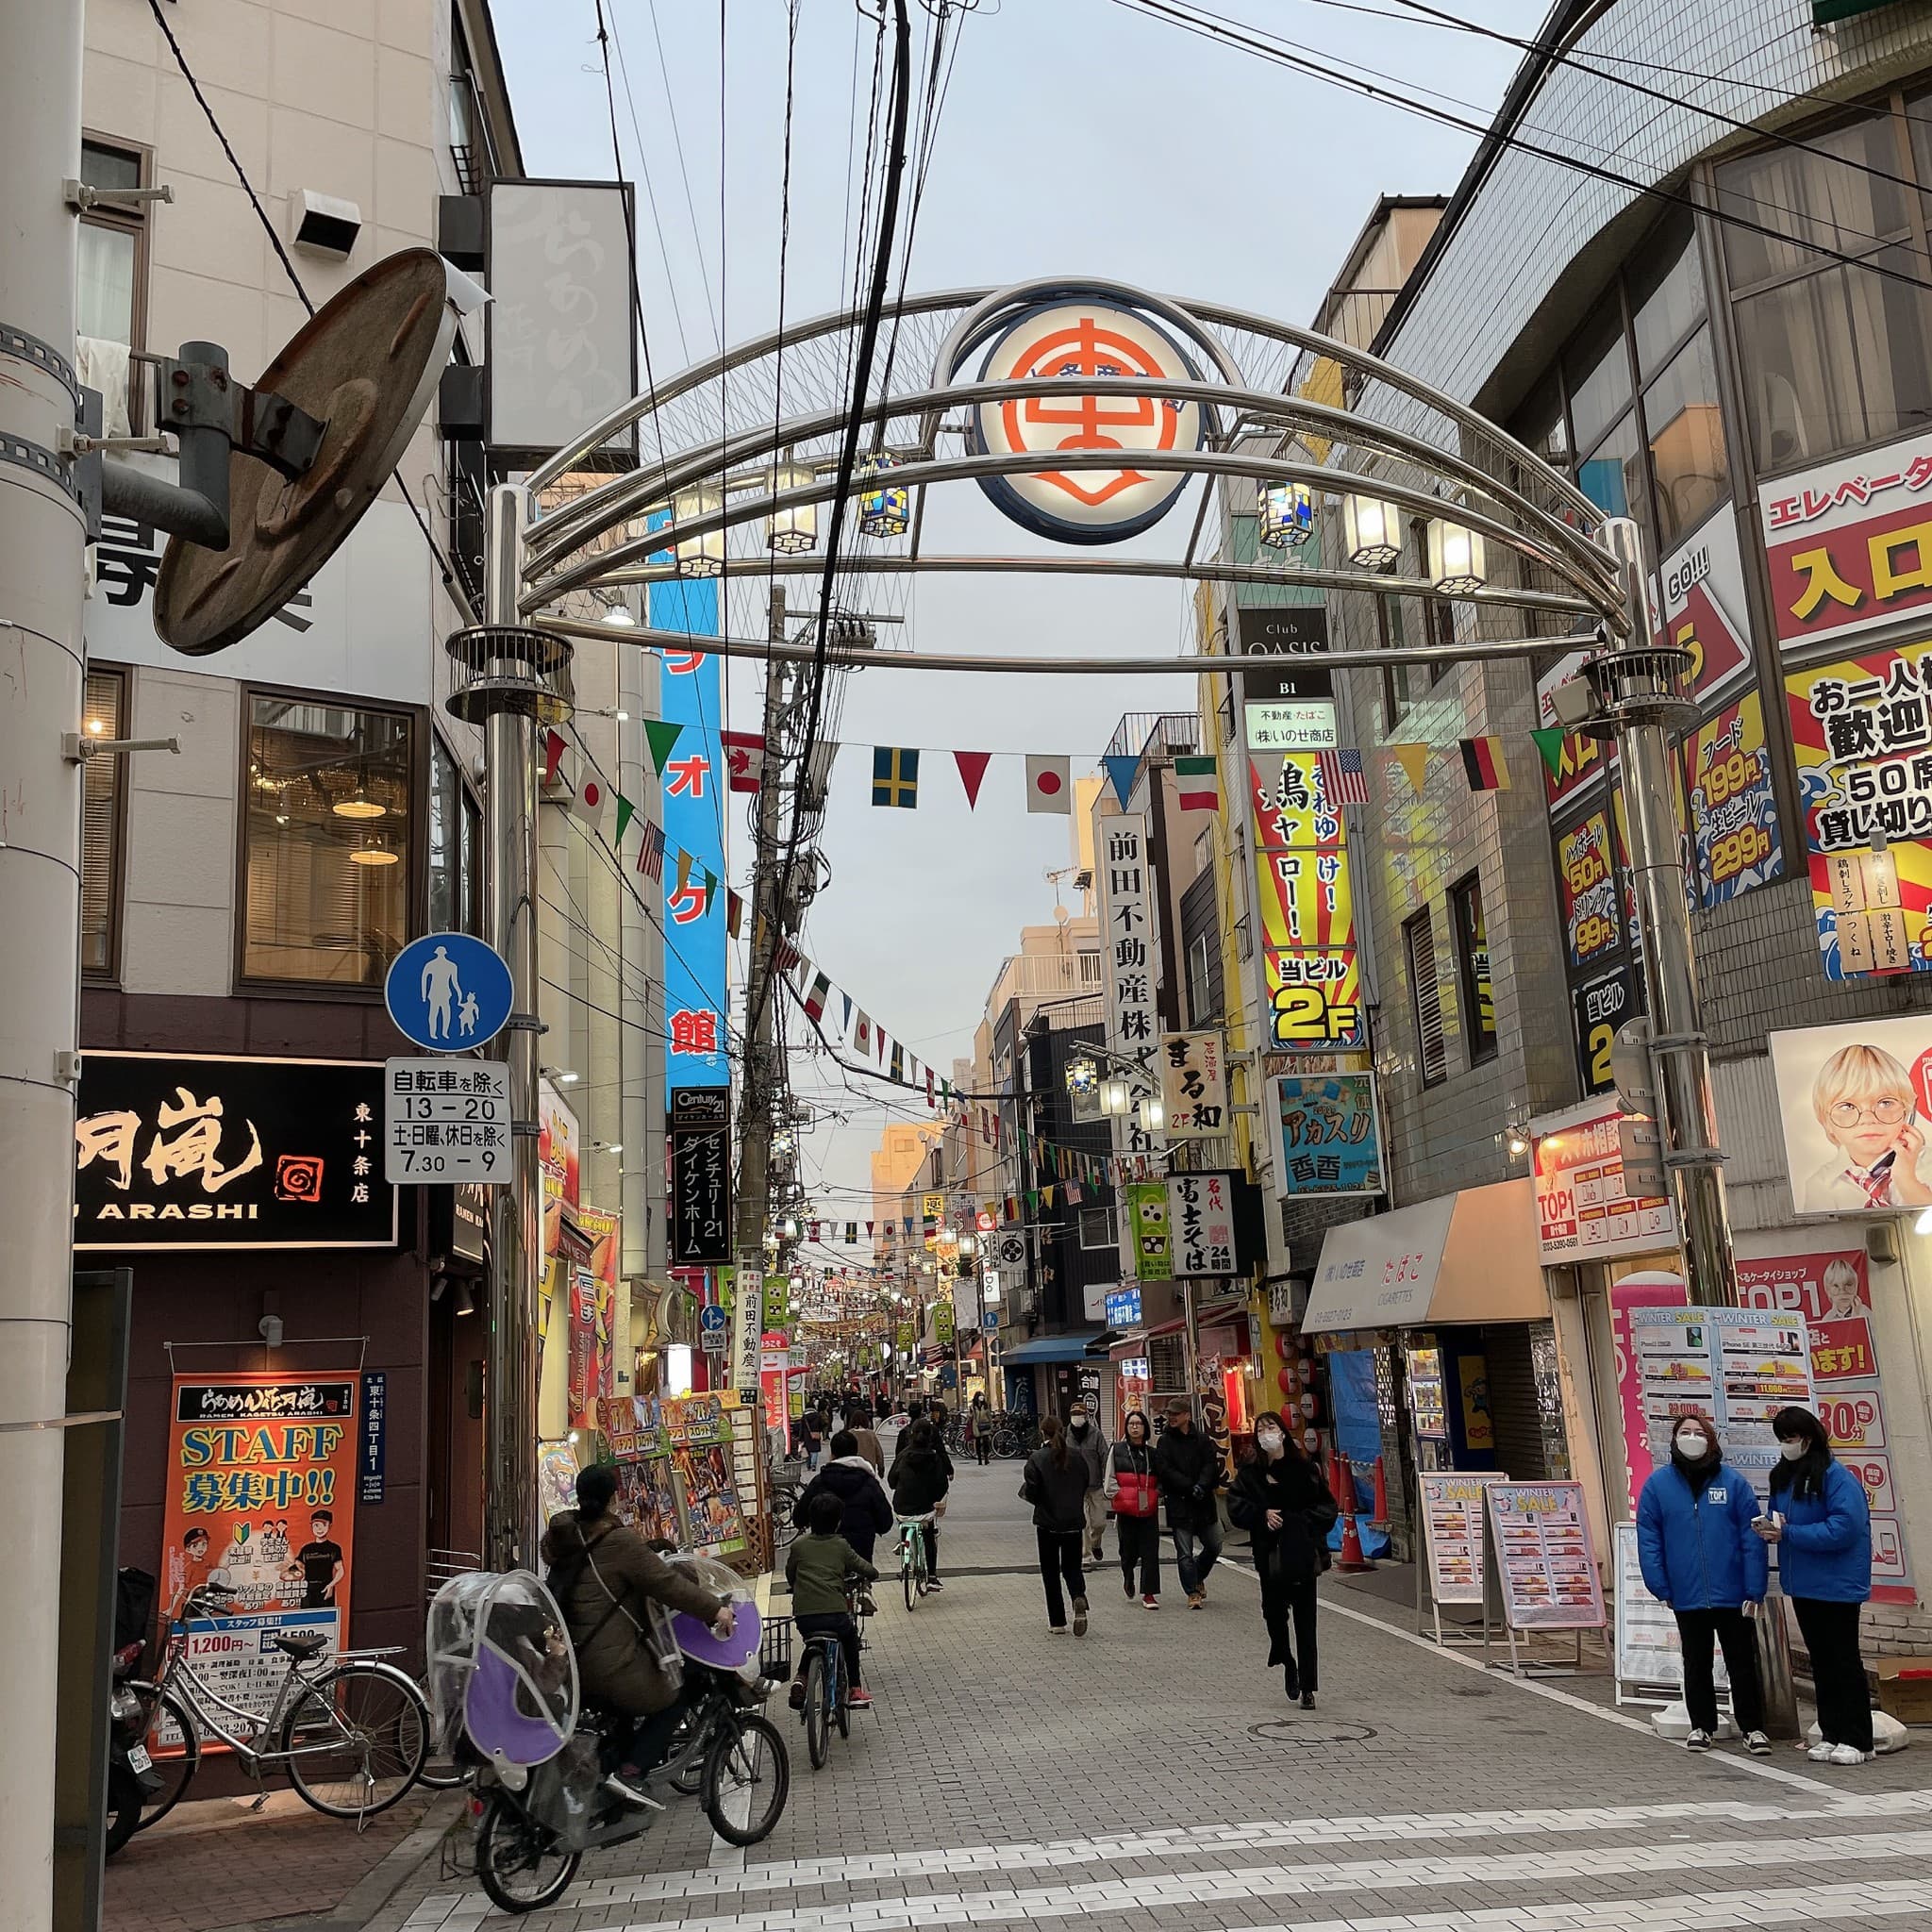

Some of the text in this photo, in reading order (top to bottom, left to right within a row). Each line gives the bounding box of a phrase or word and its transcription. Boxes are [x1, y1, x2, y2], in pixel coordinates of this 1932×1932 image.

[1789, 520, 1932, 620] 入口
[1266, 624, 1298, 634] Club
[1279, 682, 1296, 693] B1
[1827, 697, 1926, 758] 歓迎
[1847, 921, 1861, 957] つくね
[1280, 959, 1346, 983] 当ビル
[1274, 985, 1357, 1041] 2F
[394, 1070, 503, 1094] 自転車を除く
[713, 1100, 724, 1112] 21
[1172, 1113, 1190, 1128] 2F
[1282, 1109, 1371, 1148] アカスリ
[350, 1102, 373, 1204] 東十条店
[684, 1136, 701, 1256] ダイケンホーム
[1207, 1178, 1224, 1211] 名代
[1538, 1188, 1575, 1228] TOP1
[96, 1203, 258, 1220] ARASHI
[1176, 1177, 1209, 1272] 富士そば
[1211, 1246, 1229, 1257] 24
[741, 1293, 757, 1368] 前田不動産
[1639, 1312, 1705, 1324] WINTER SALE
[1721, 1313, 1798, 1326] WINTER SALE
[181, 1424, 343, 1465] STAFF
[184, 1468, 336, 1512] 募集中!!
[1445, 1477, 1482, 1487] WINTER
[1515, 1488, 1555, 1497] WINTER
[1517, 1497, 1557, 1511] SALE
